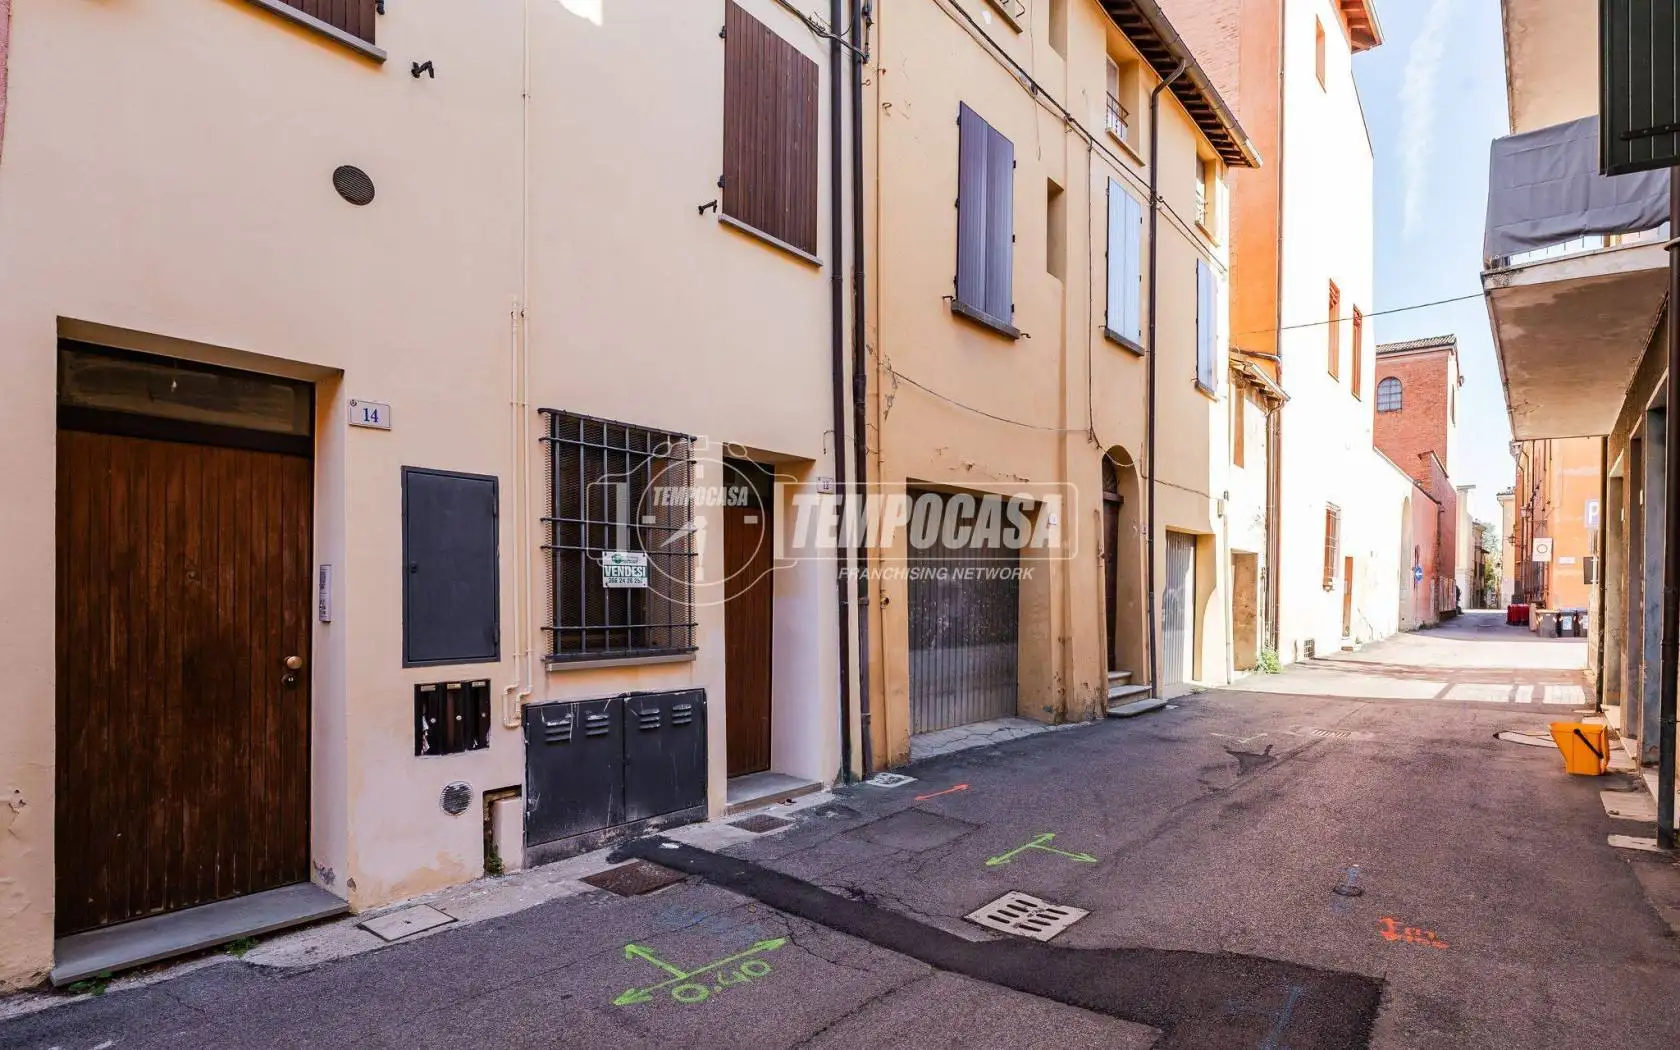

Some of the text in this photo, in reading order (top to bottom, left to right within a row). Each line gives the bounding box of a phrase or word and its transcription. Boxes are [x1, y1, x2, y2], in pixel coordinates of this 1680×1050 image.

[363, 407, 379, 423] 14
[1588, 501, 1600, 525] P
[604, 565, 647, 578] VENDESI
